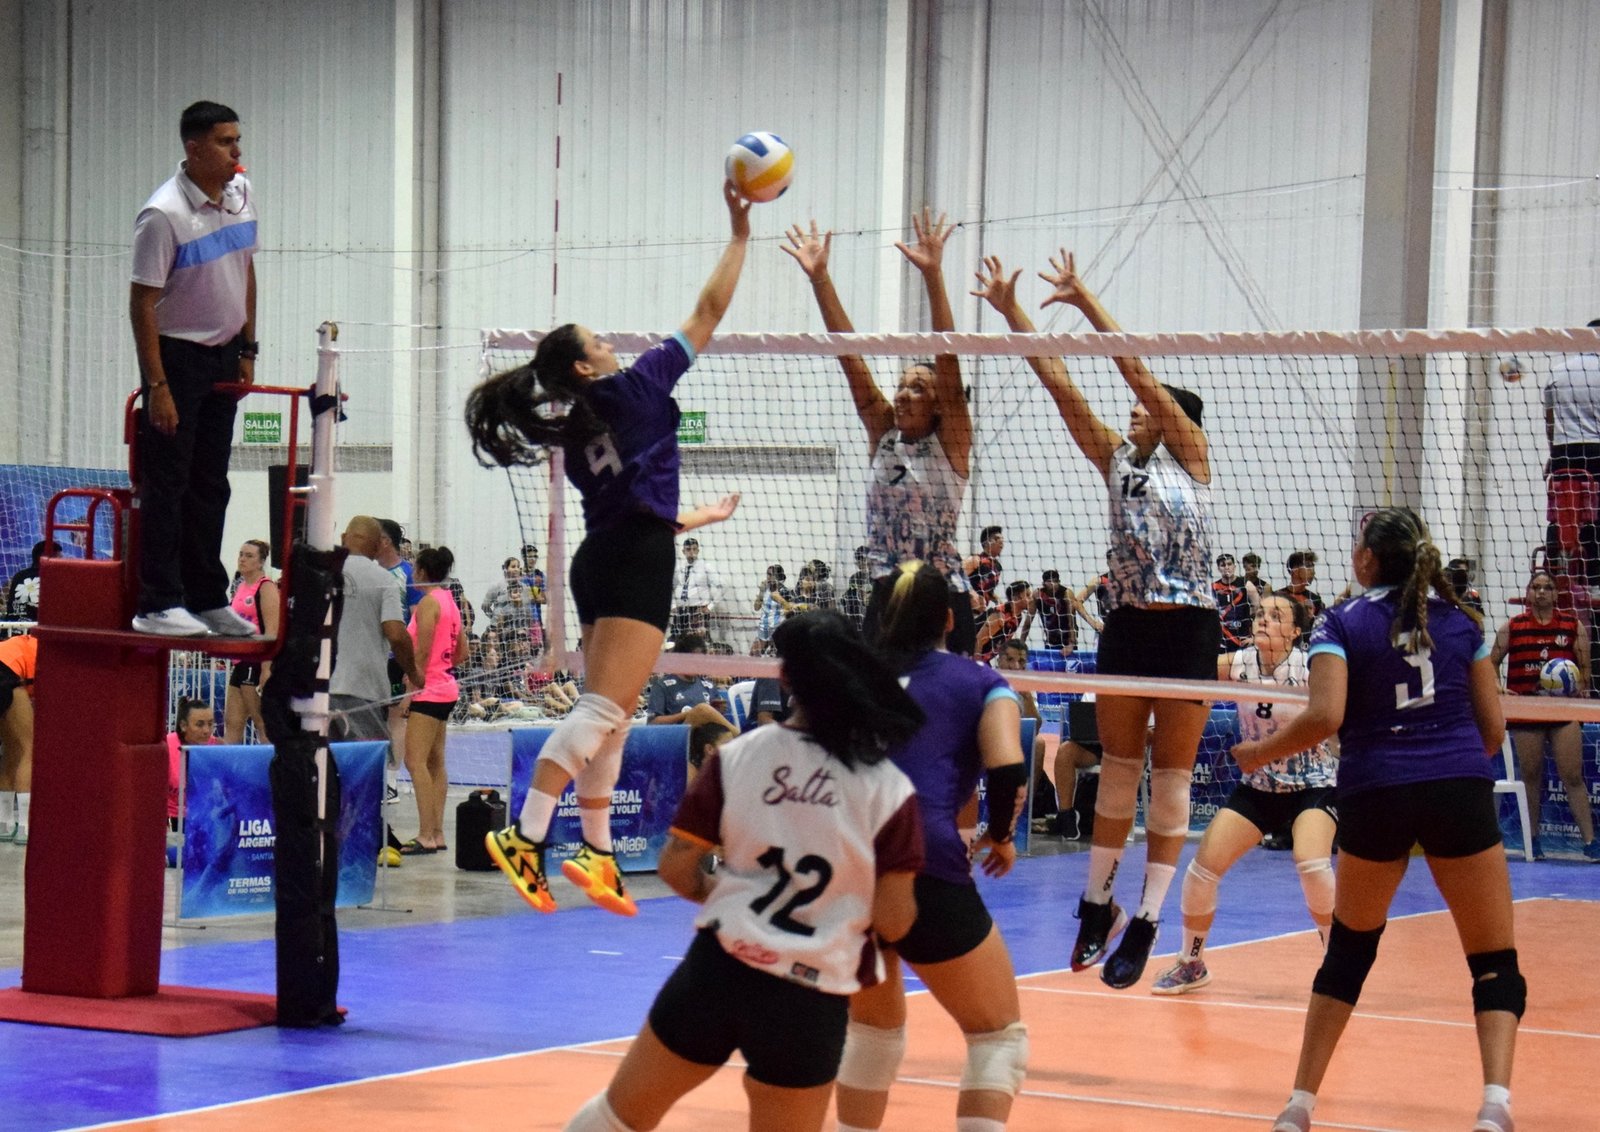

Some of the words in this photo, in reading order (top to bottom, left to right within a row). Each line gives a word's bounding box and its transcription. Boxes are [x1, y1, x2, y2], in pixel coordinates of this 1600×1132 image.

[245, 419, 279, 429] SALIDA
[889, 465, 906, 486] 7
[1121, 473, 1150, 498] 12
[1393, 631, 1436, 710] 3
[1255, 701, 1273, 719] 8
[763, 766, 838, 808] Salta
[616, 805, 642, 814] VOLEY
[239, 819, 272, 836] LIGA
[238, 836, 276, 848] ARGENT
[229, 876, 271, 888] TERMAS
[749, 846, 833, 936] 12
